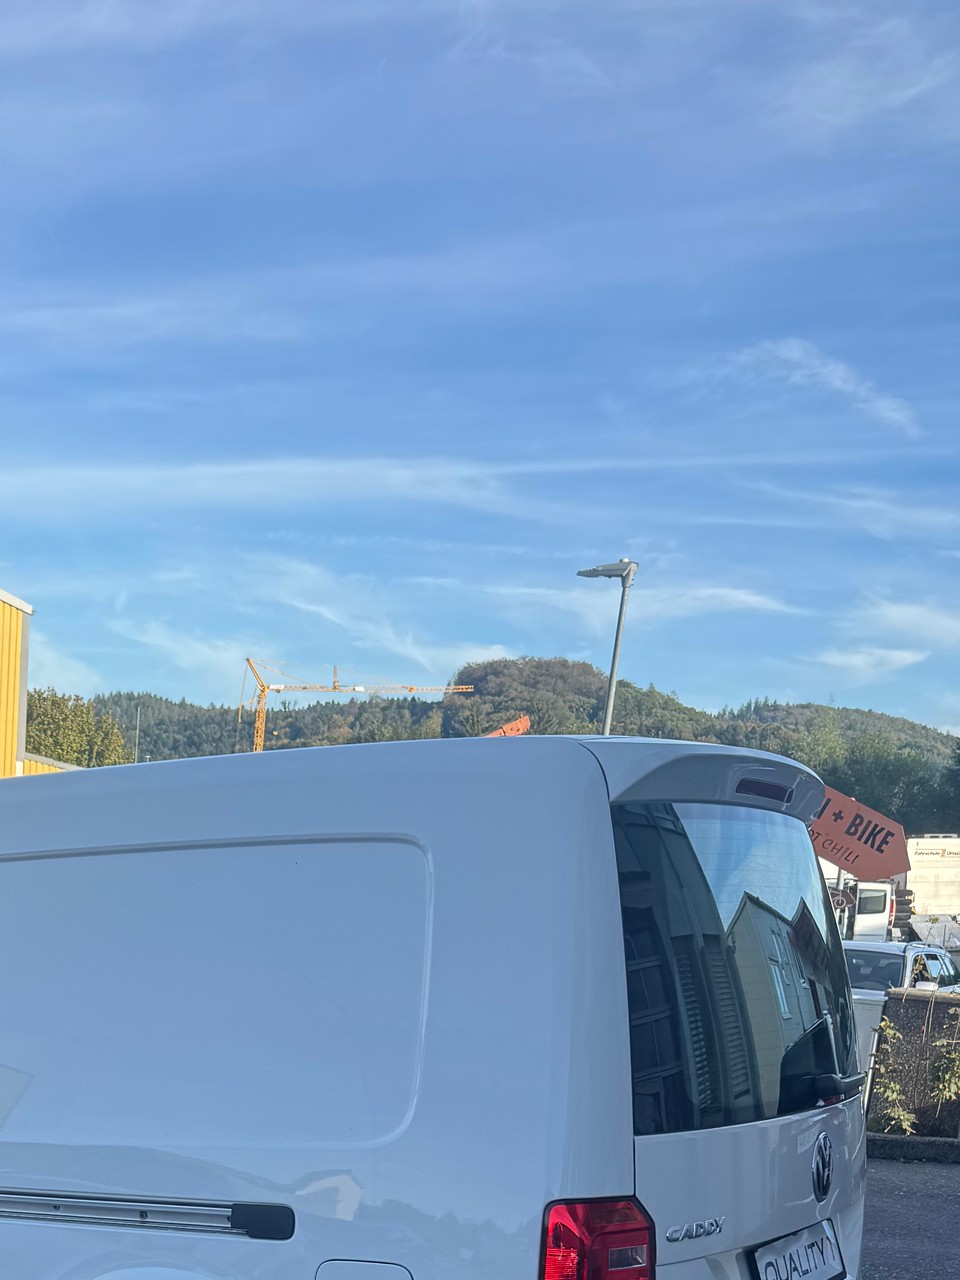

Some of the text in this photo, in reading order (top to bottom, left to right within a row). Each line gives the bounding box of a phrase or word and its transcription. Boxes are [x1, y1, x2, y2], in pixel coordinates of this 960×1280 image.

[844, 813, 895, 854] BIKE
[822, 839, 859, 864] CHILI
[666, 1216, 725, 1243] CADDY
